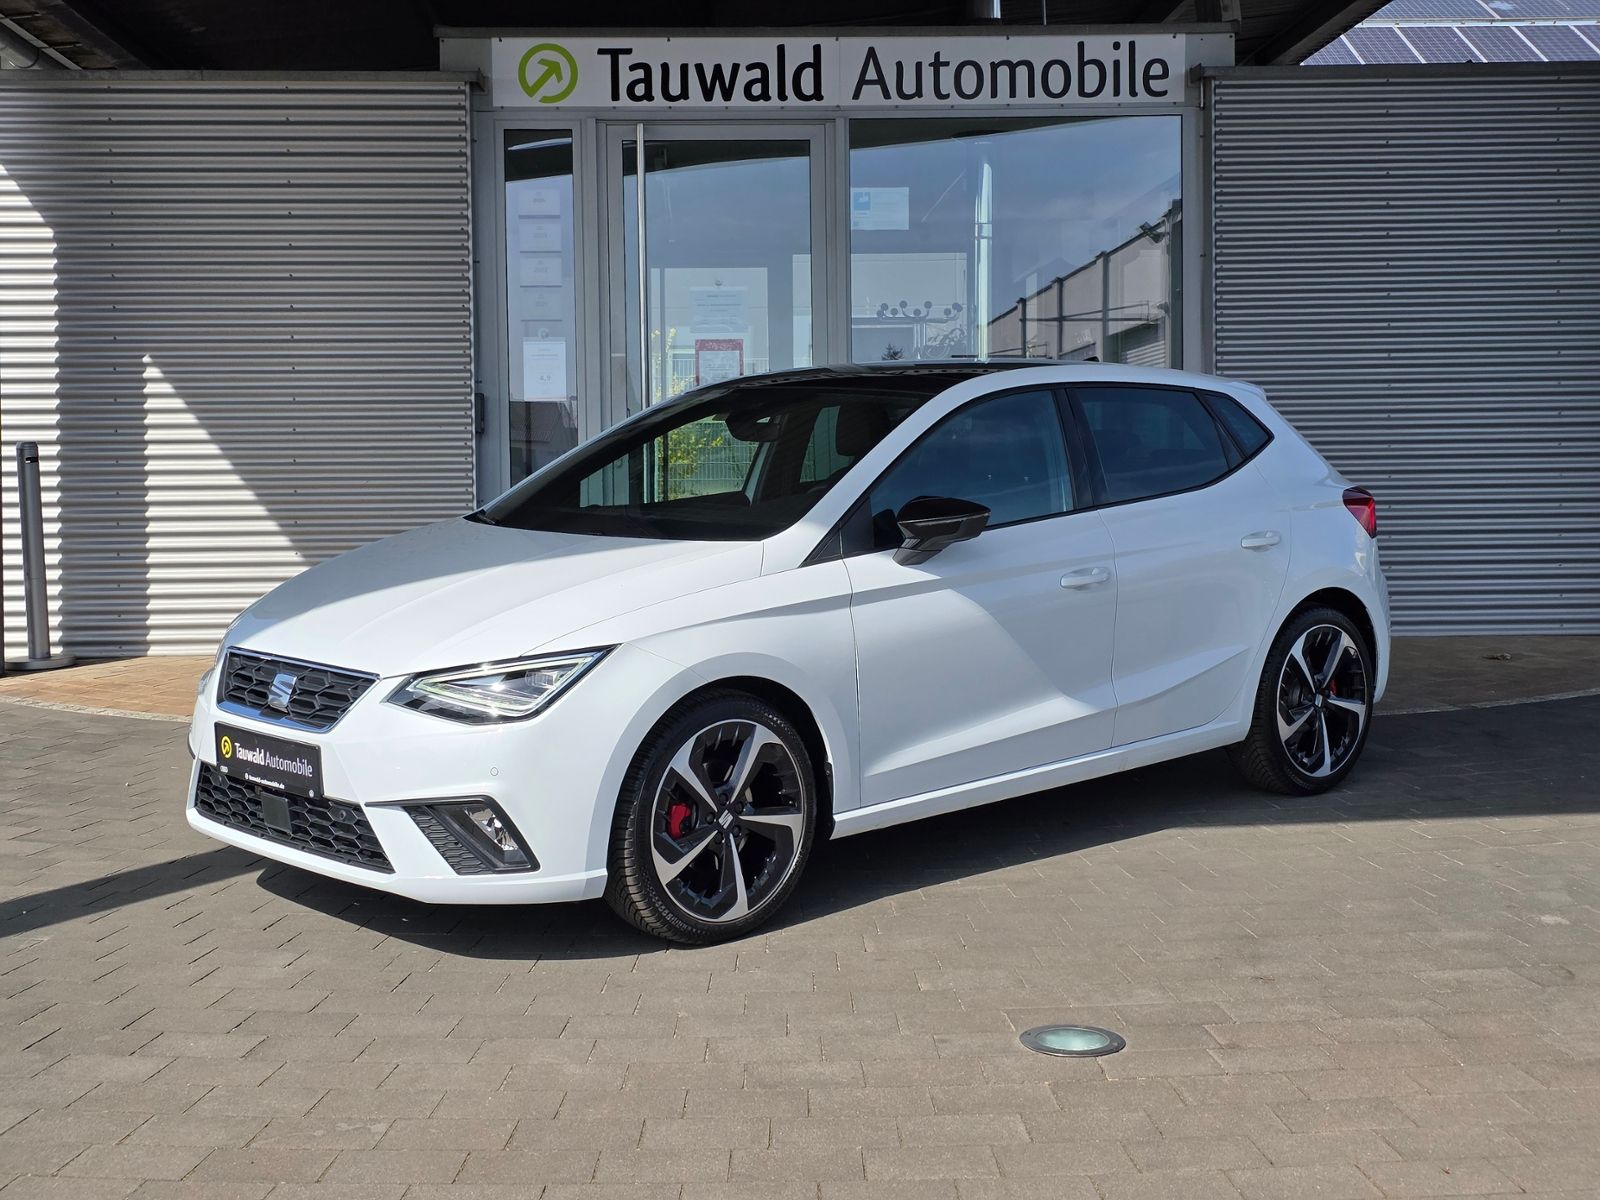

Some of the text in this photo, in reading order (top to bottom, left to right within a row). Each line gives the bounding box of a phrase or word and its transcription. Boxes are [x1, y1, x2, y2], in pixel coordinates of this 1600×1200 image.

[597, 41, 1169, 103] Tauwald Automobile
[234, 742, 313, 778] Tauwald Automobile
